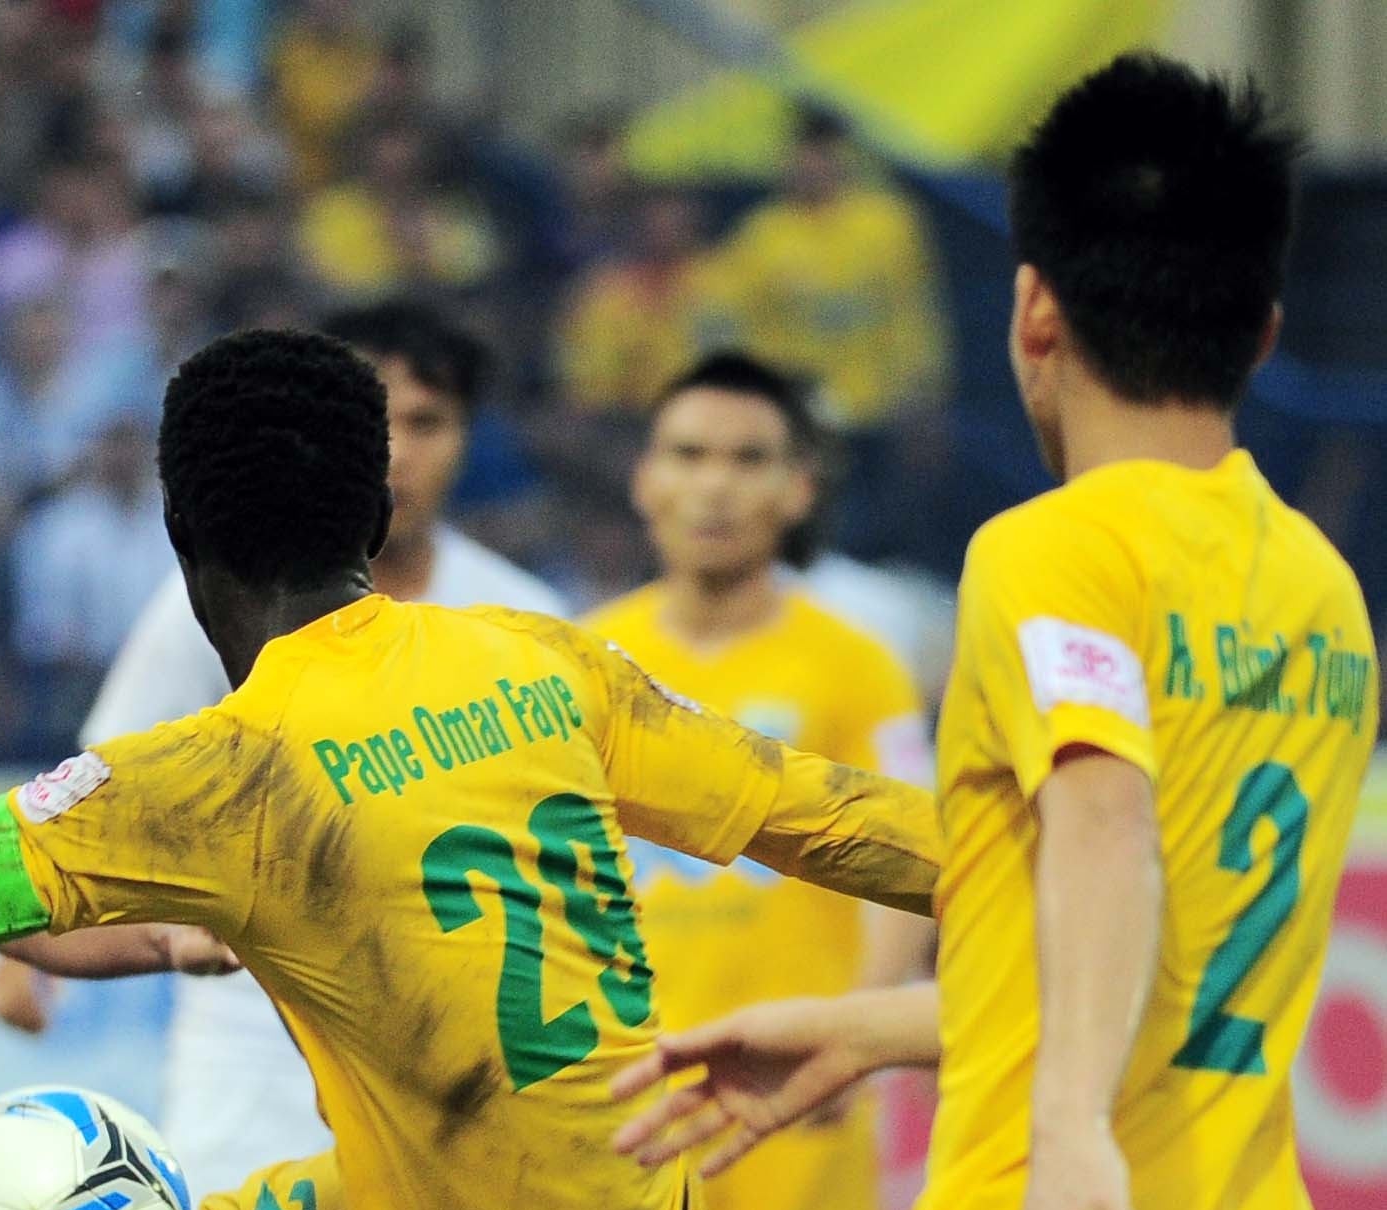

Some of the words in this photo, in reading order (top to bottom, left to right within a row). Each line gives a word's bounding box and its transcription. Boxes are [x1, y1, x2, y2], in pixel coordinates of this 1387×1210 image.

[312, 737, 424, 805] Pape
[412, 696, 513, 770] Omar
[495, 675, 582, 743] Faye
[421, 792, 655, 1093] 29
[1168, 759, 1311, 1076] 2
